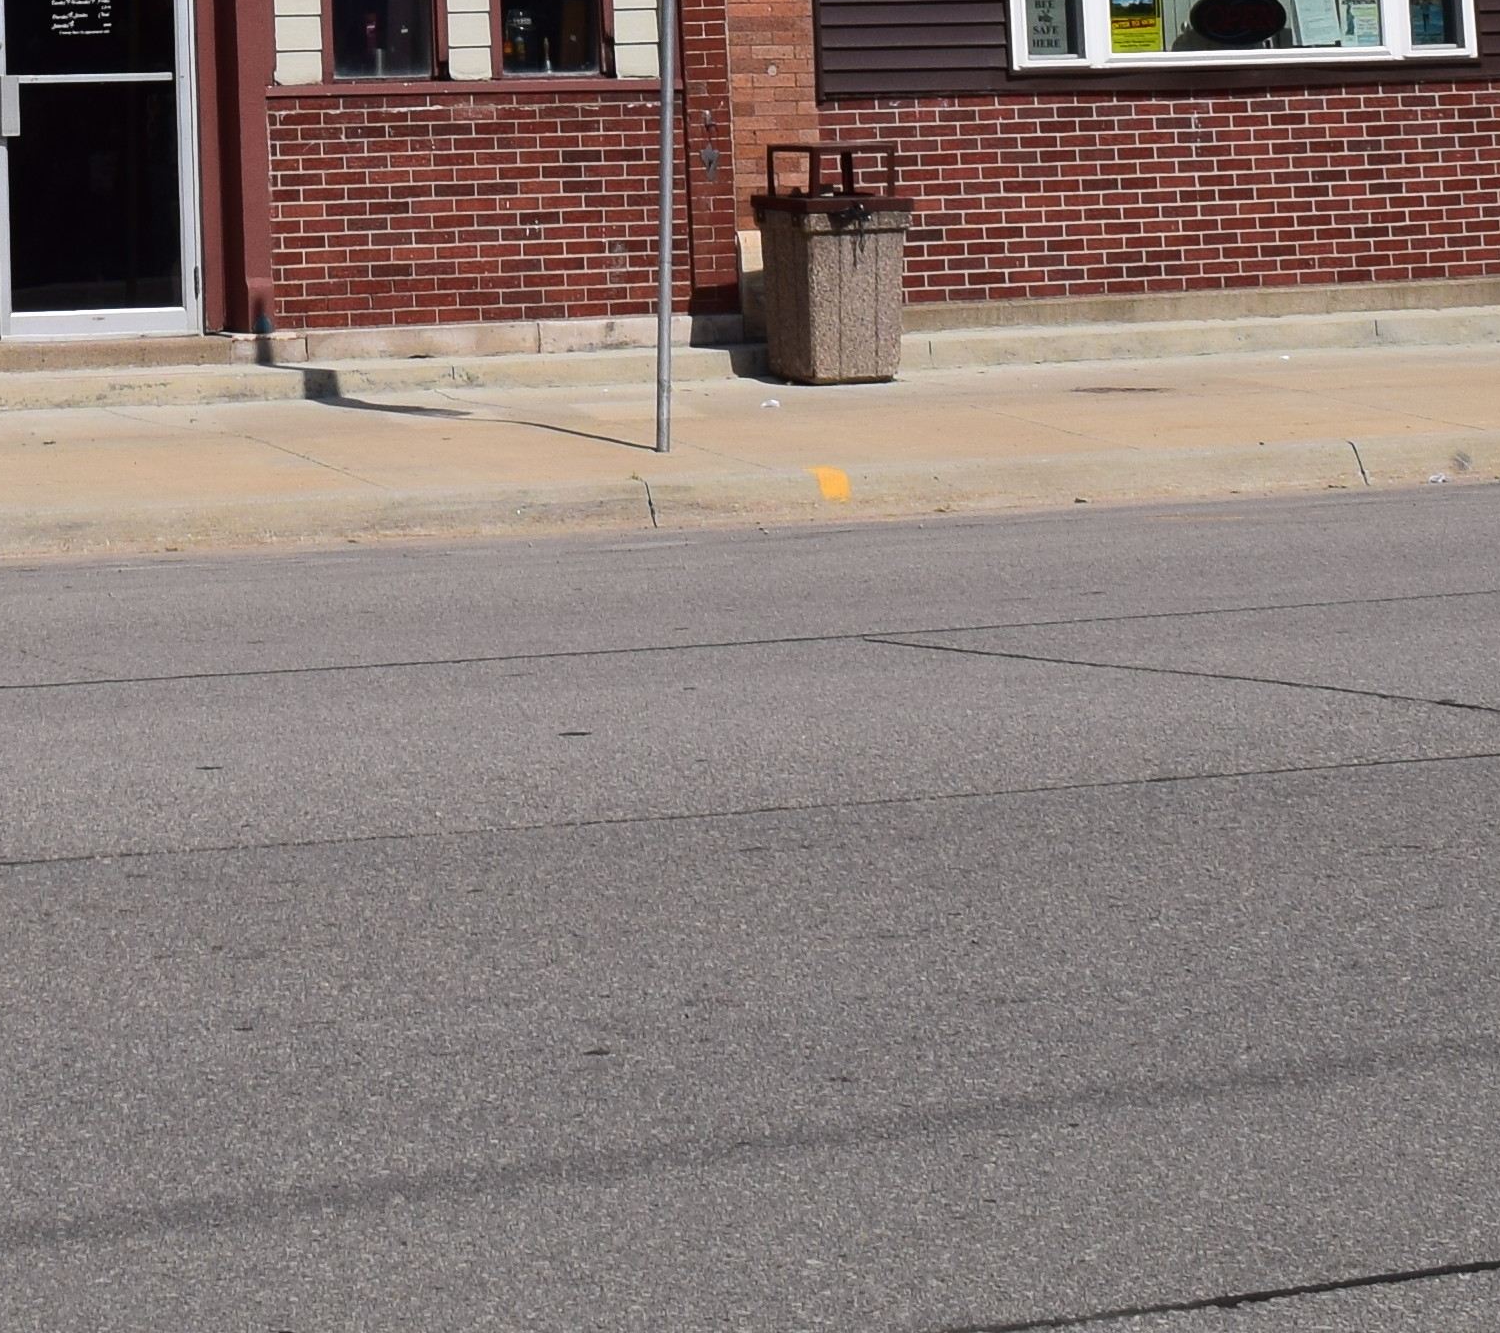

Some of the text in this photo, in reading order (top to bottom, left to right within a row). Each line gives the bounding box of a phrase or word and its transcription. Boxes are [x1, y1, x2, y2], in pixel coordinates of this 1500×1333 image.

[1034, 0, 1055, 9] BEE
[1032, 25, 1059, 35] SAFE
[1032, 38, 1061, 48] HERE
